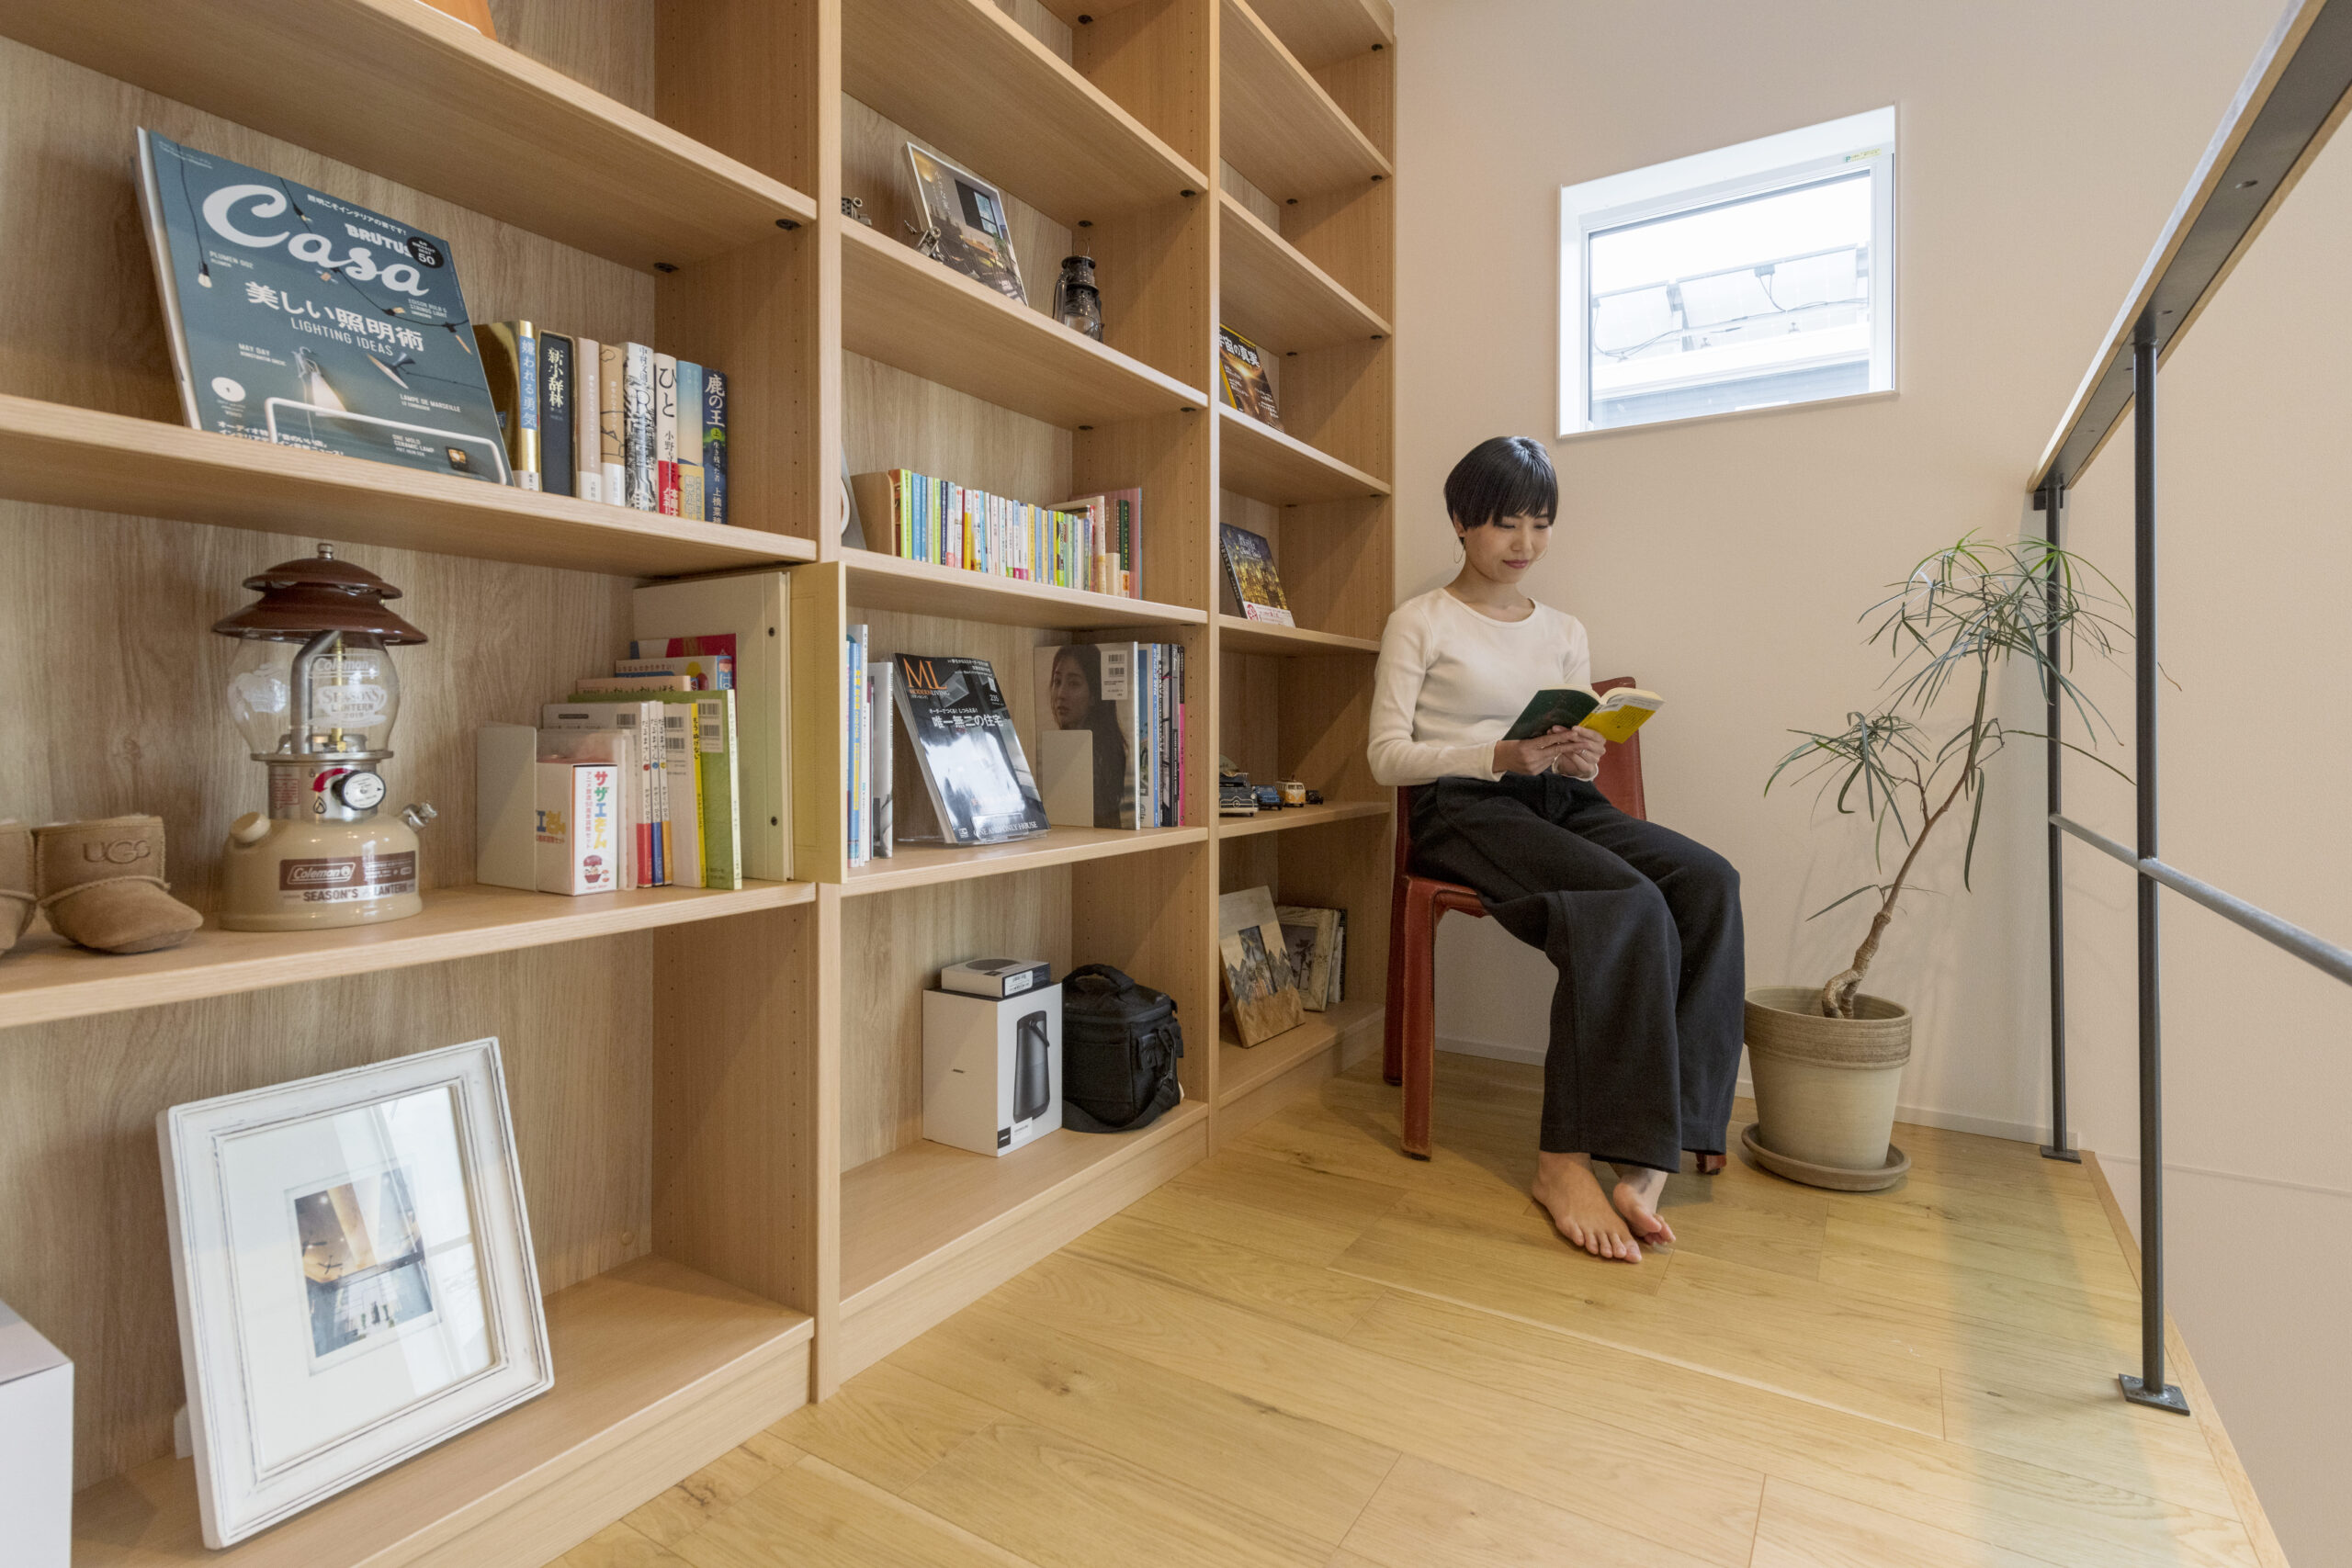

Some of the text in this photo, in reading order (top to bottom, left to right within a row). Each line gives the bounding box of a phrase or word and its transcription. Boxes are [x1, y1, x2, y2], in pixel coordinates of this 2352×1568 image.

[202, 184, 429, 297] Casa
[418, 252, 435, 265] 50
[244, 280, 424, 352] 美しい照明術
[290, 317, 393, 356] LIGHTING IDEAS
[522, 340, 537, 428] 嫌われる勇気
[659, 368, 677, 418] ひと
[705, 374, 726, 428] 鹿の王
[903, 657, 947, 690] ML
[932, 714, 1004, 728] 唯一無二の住宅
[594, 771, 609, 850] サザエさん
[1019, 820, 1038, 830] HOUSE
[83, 839, 152, 864] UGG
[293, 866, 340, 879] Coleman
[303, 888, 358, 902] SEASON'S
